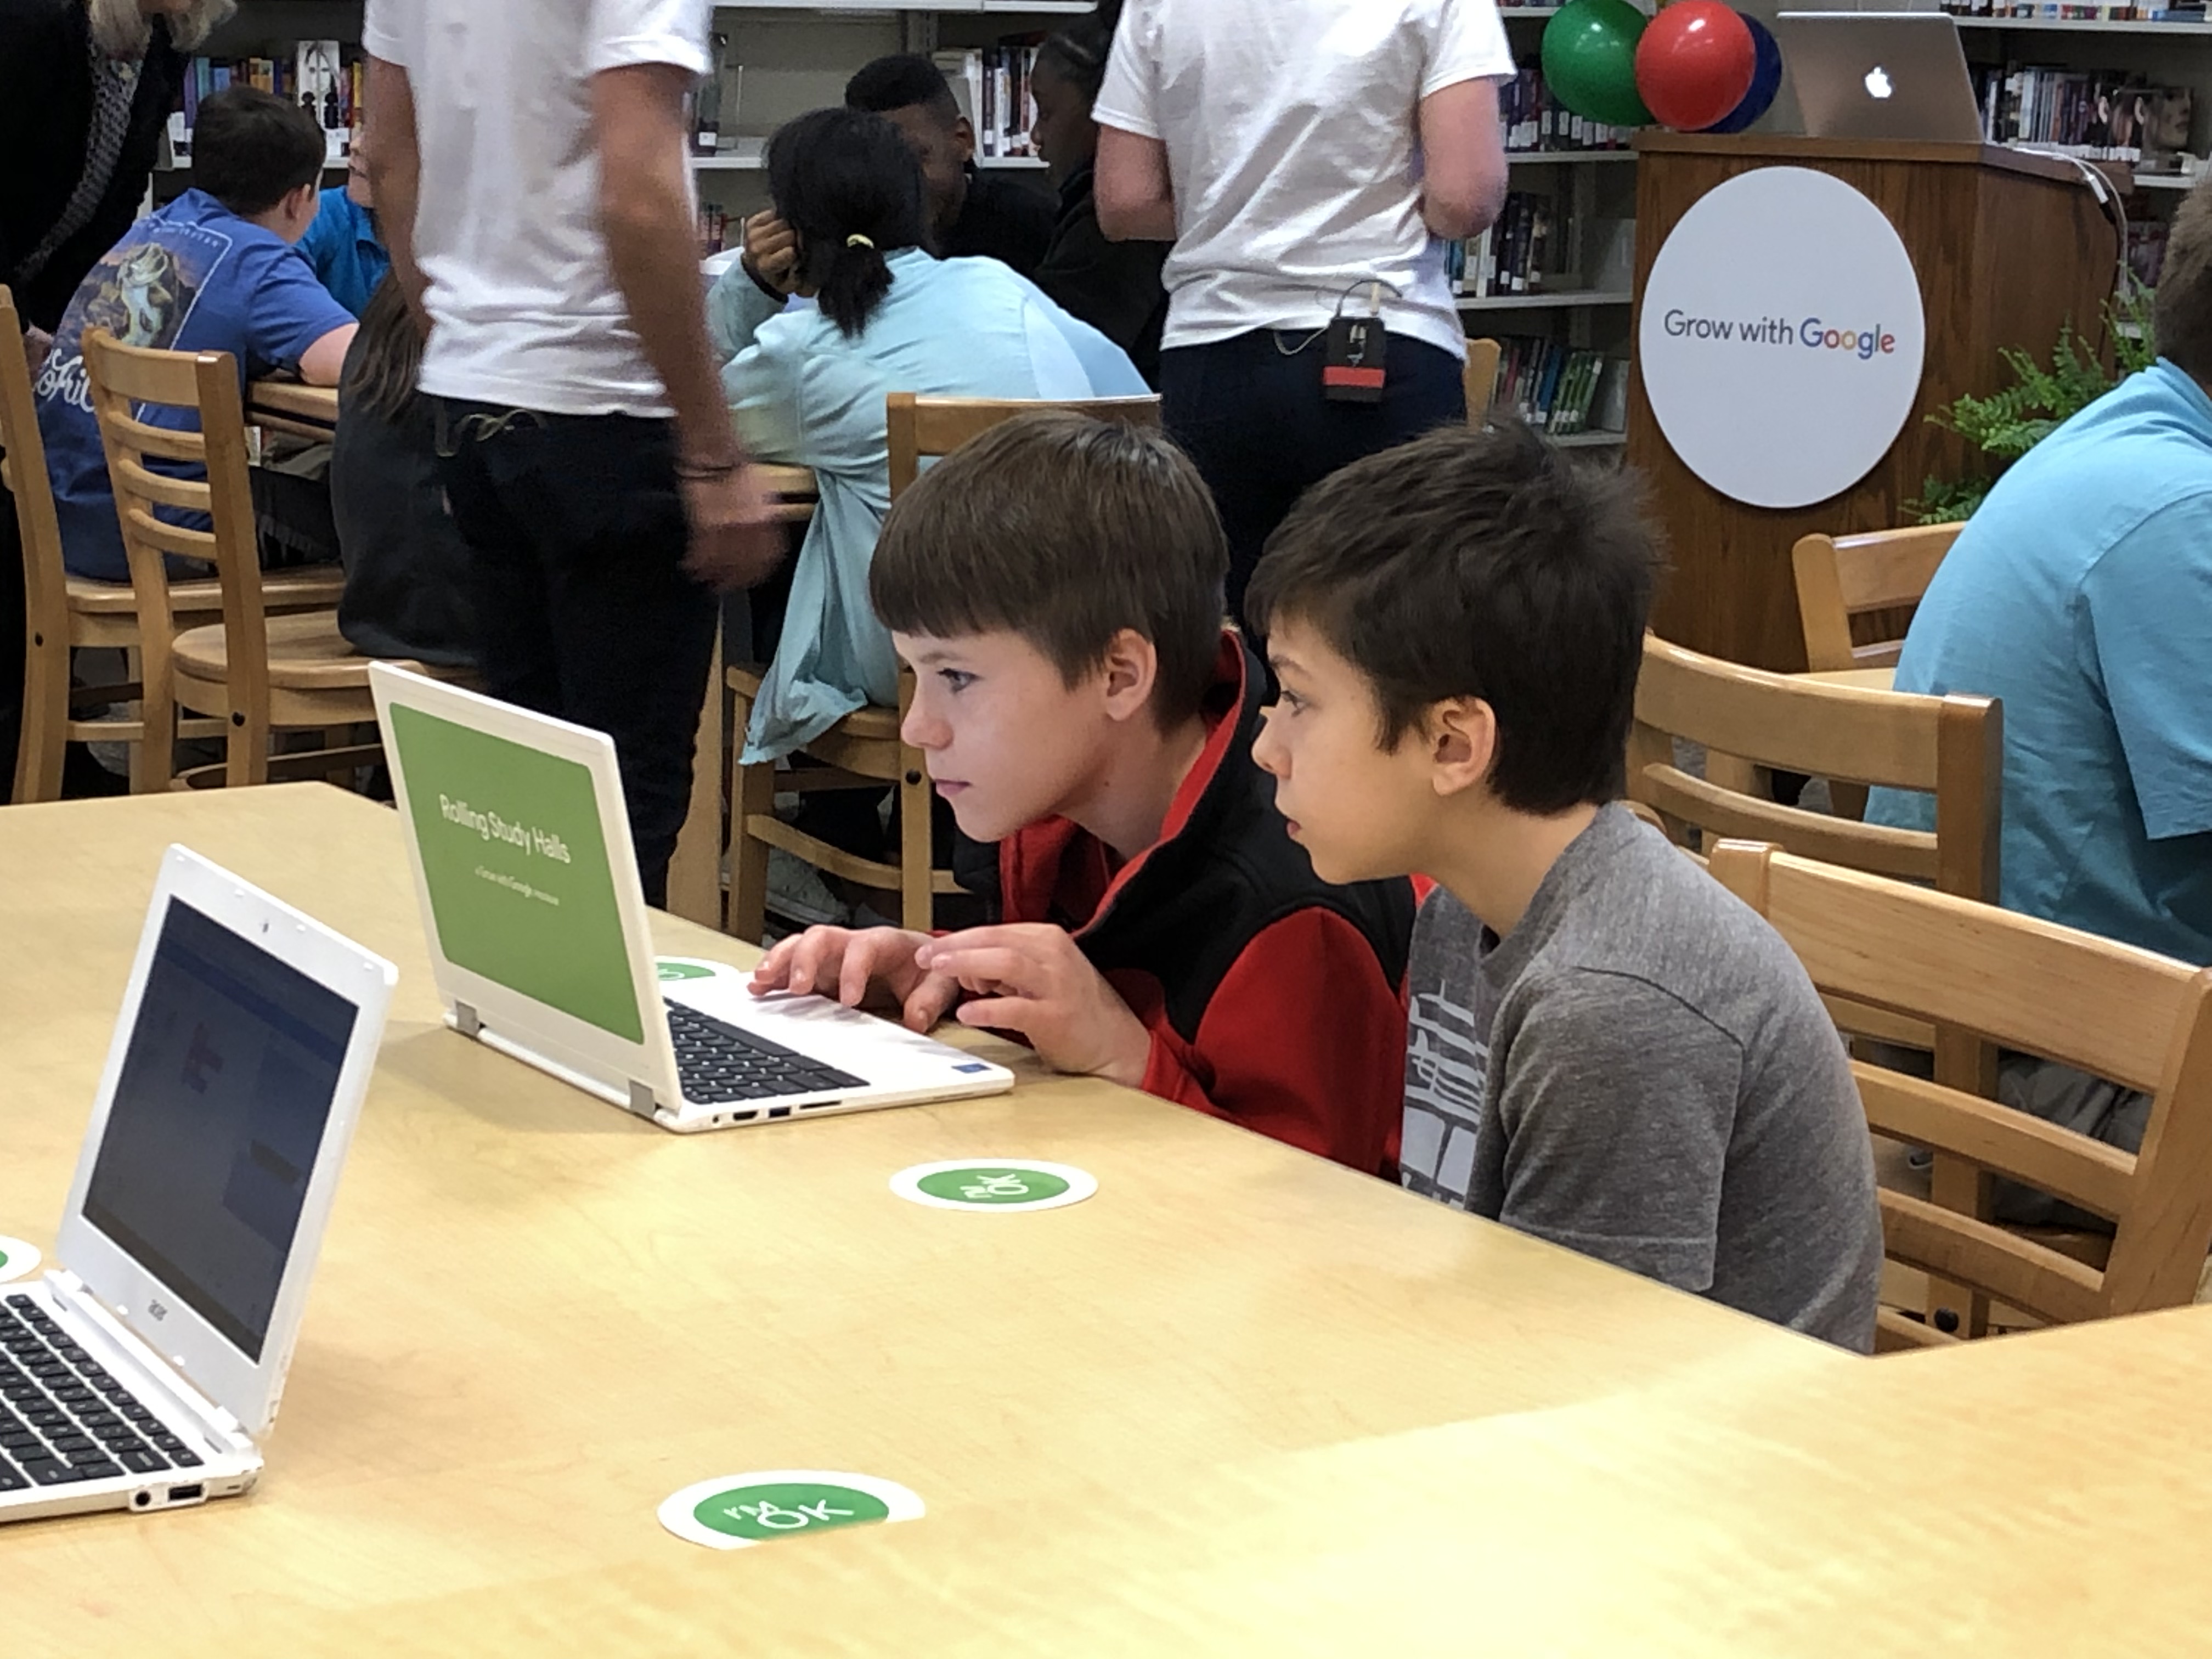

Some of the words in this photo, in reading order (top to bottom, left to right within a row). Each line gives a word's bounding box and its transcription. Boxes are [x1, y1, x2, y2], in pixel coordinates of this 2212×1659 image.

[1664, 309, 1734, 340] Grow
[1739, 317, 1793, 345] with
[1799, 318, 1895, 360] Google
[439, 793, 490, 841] Rolling
[488, 811, 531, 856] Study
[532, 826, 571, 864] Halls
[757, 1499, 855, 1529] OK
